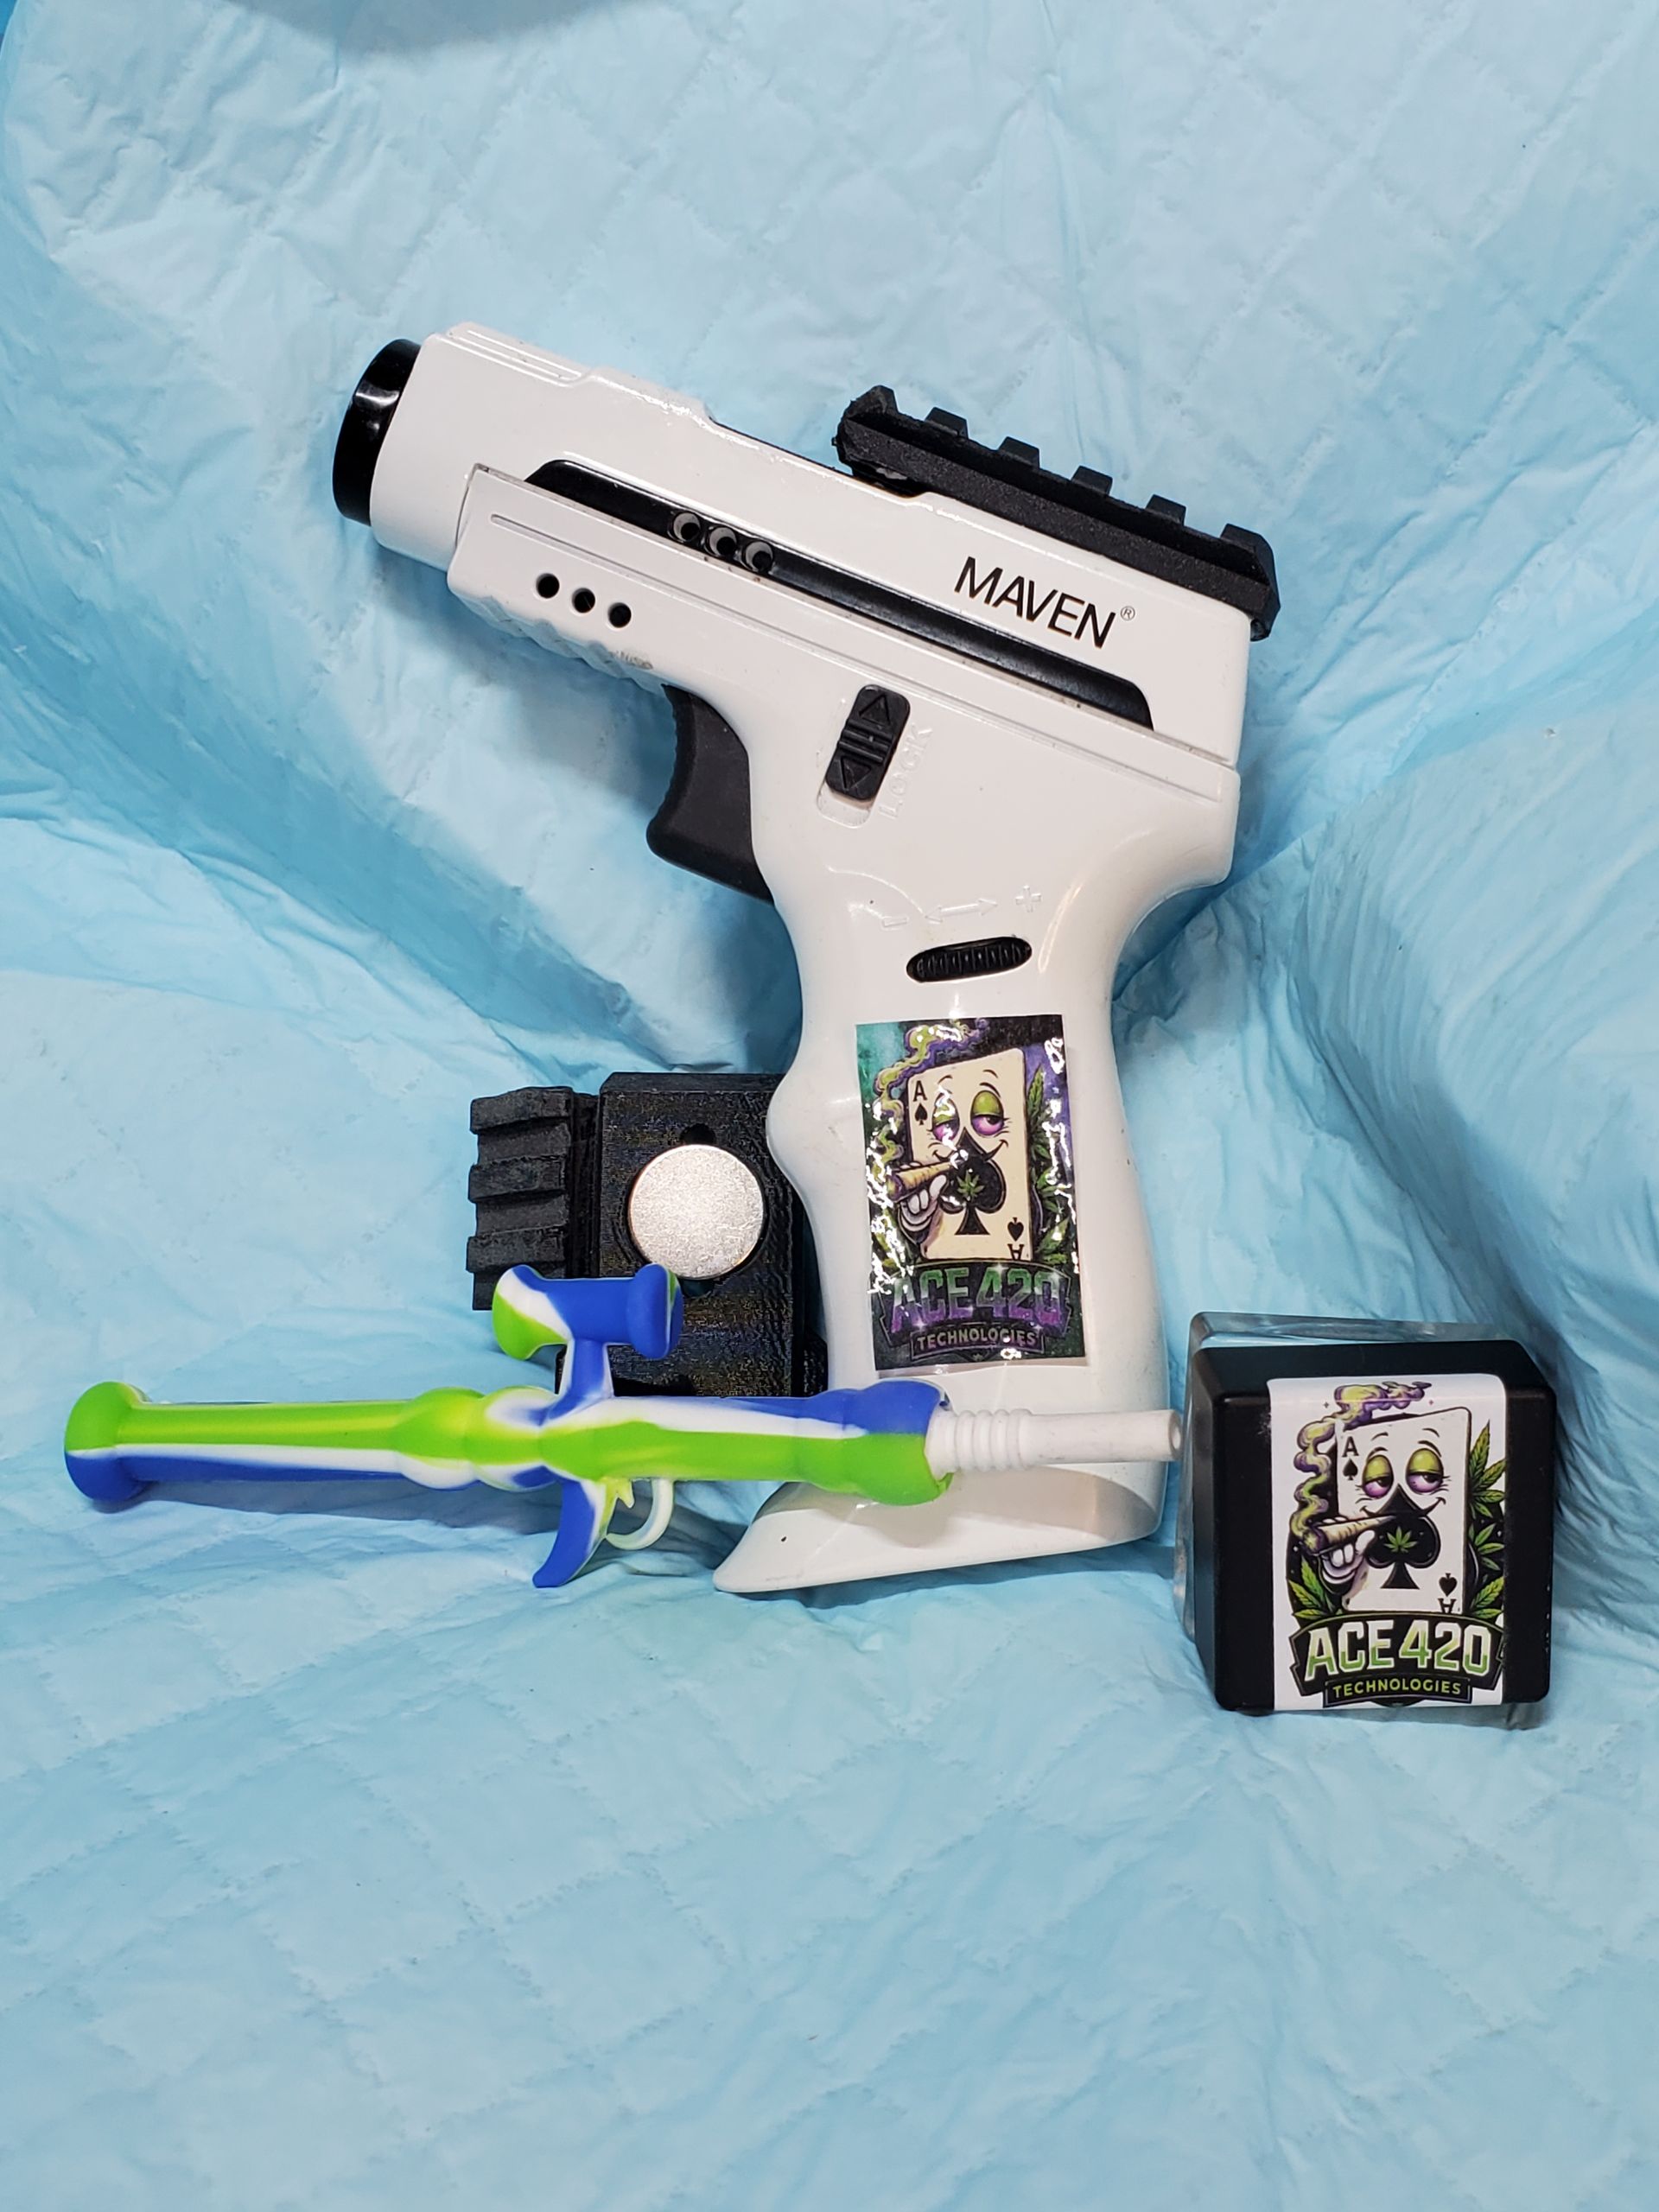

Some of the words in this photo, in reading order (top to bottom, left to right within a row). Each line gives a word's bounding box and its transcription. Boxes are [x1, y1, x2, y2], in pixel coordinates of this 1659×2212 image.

[912, 1079, 928, 1102] A
[890, 1268, 969, 1334] ACE
[976, 1266, 1064, 1323] 420
[917, 1326, 1037, 1351] TECHNOLOGIES
[1342, 1436, 1359, 1457] A
[1304, 1619, 1394, 1682] ACE
[1399, 1618, 1491, 1675] 420
[1332, 1677, 1462, 1699] TECHNOLOGIES
